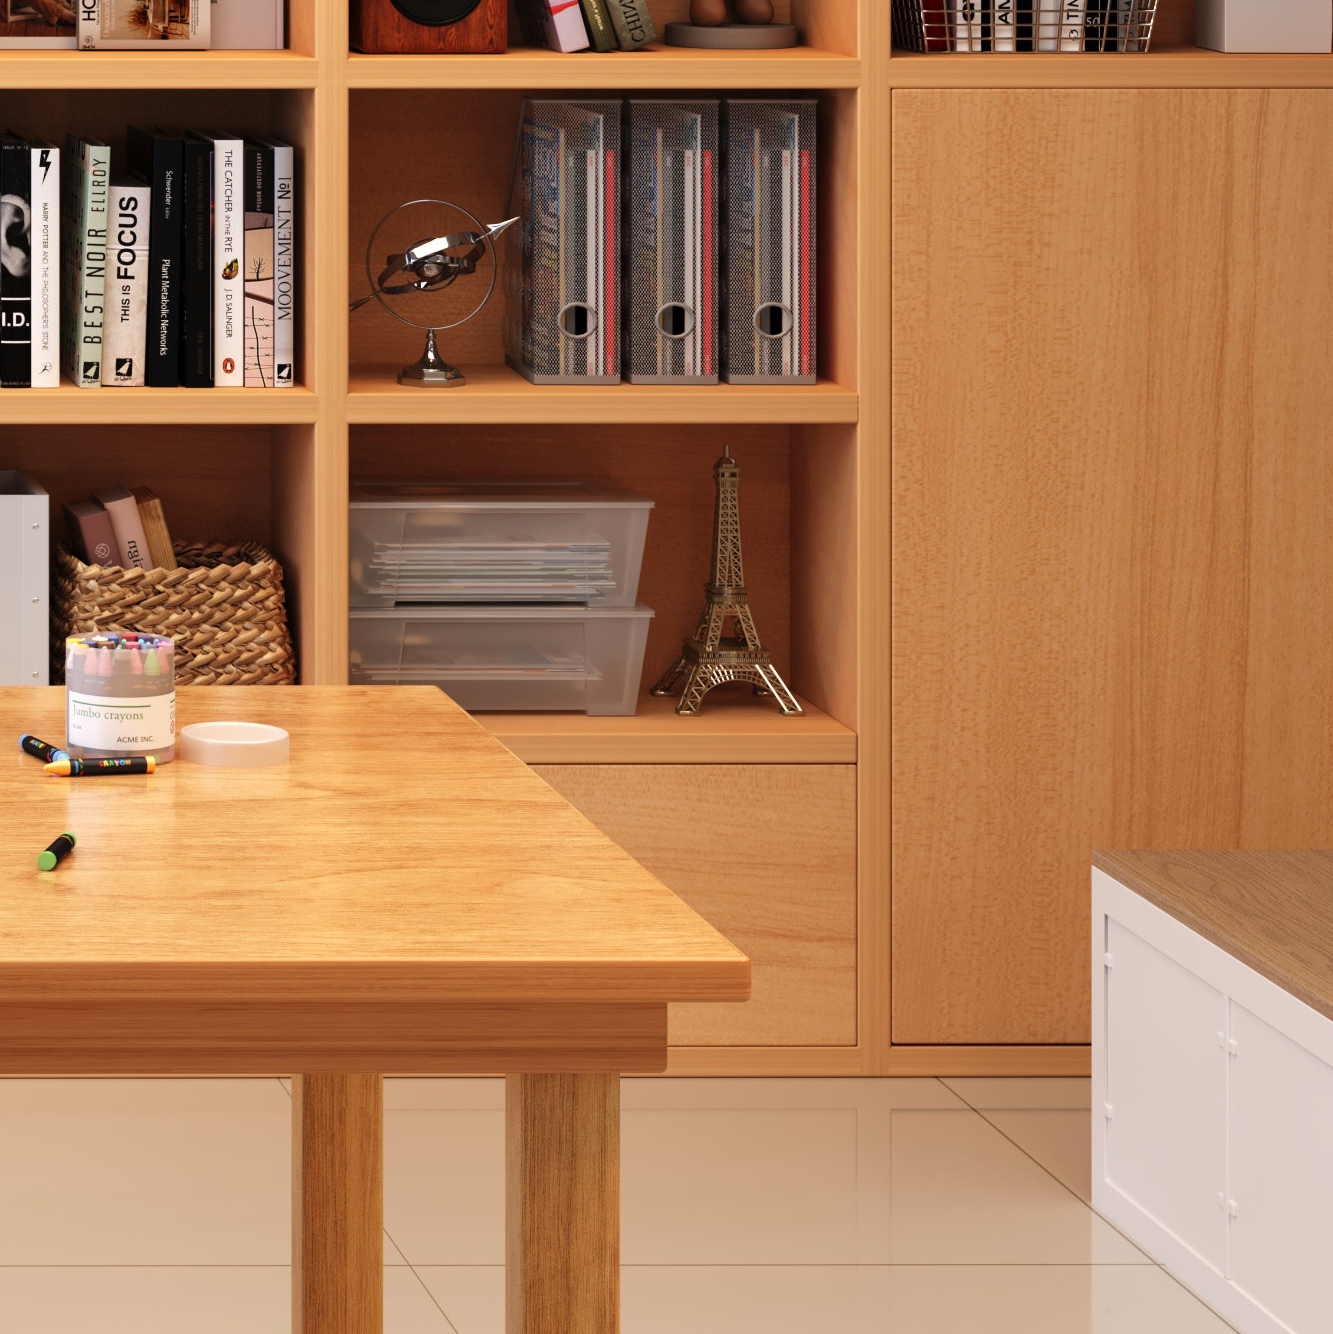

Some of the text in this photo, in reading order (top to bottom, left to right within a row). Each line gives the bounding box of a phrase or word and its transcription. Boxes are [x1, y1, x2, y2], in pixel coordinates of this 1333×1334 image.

[224, 150, 233, 213] THE CATCHER
[117, 196, 138, 280] FOCUS
[73, 704, 144, 723] Jumbo crayons
[99, 759, 131, 767] CRAYON
